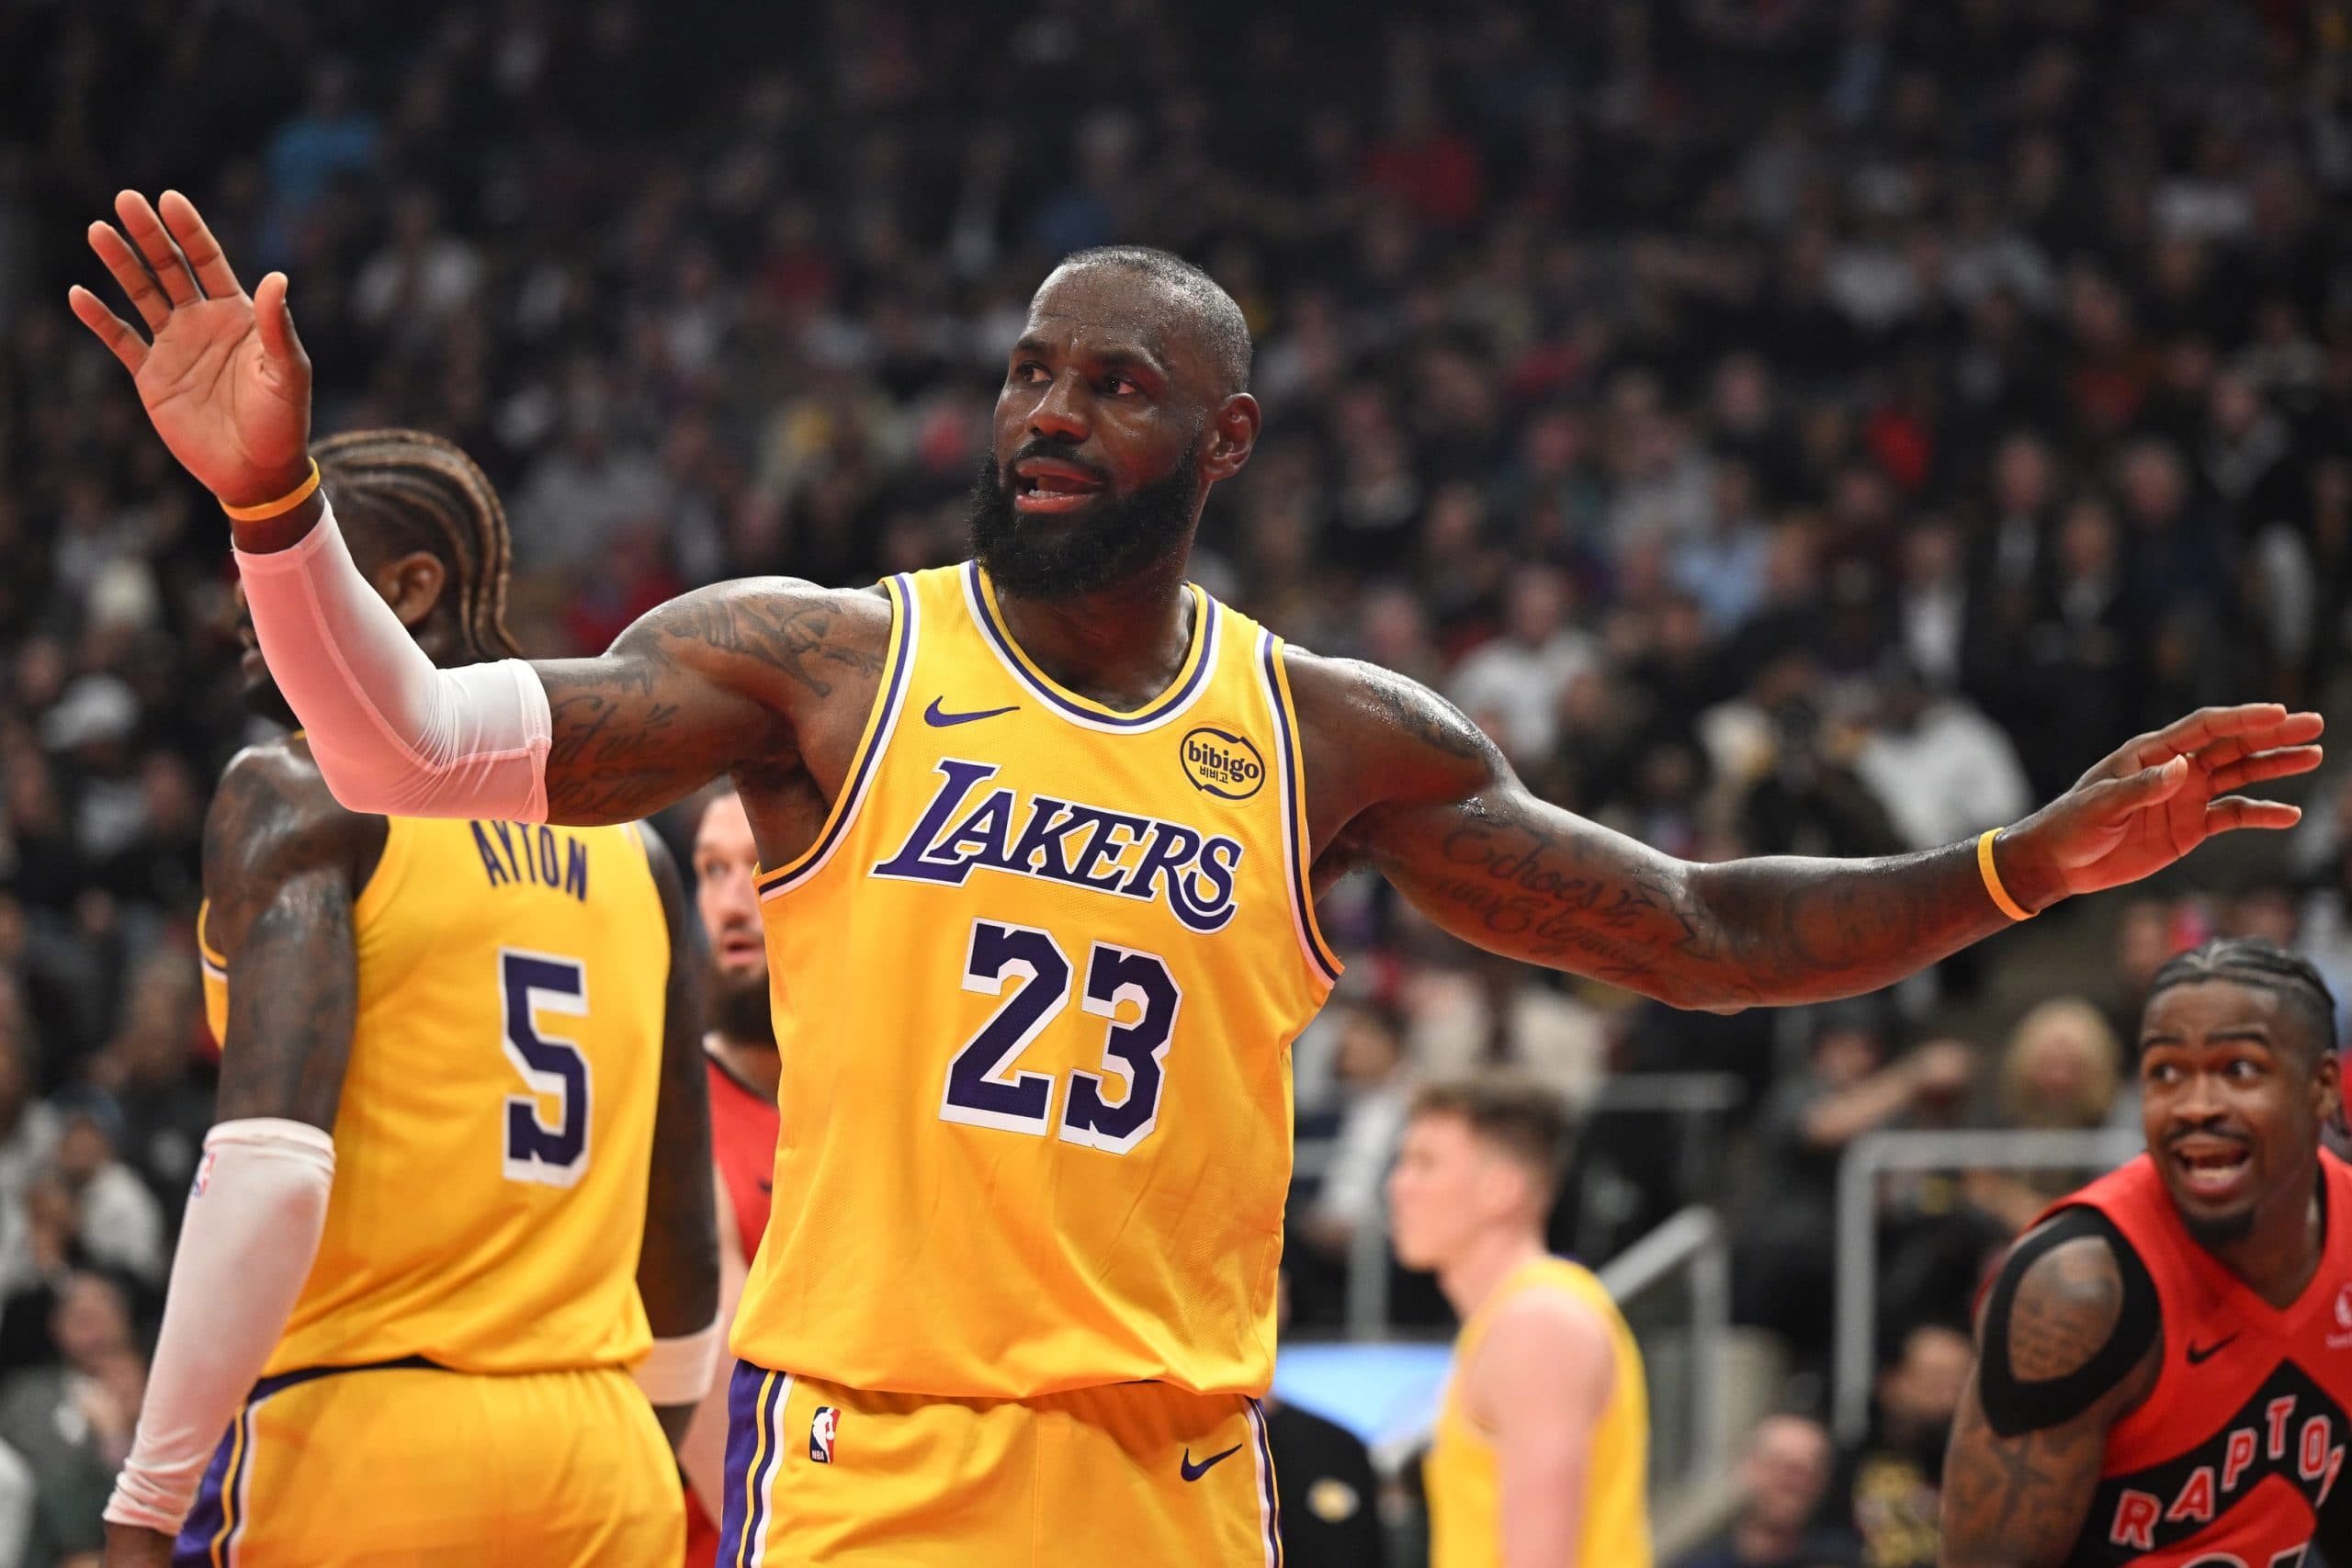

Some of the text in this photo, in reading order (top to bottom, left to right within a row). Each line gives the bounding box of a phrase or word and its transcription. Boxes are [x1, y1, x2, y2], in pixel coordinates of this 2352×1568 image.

[1188, 739, 1260, 784] bibigo
[1199, 765, 1229, 784] 비비고
[470, 819, 588, 902] AYTON
[868, 756, 1246, 935] LAKERS
[499, 946, 592, 1189] 5
[938, 916, 1183, 1156] 23
[812, 1450, 825, 1461] NBA
